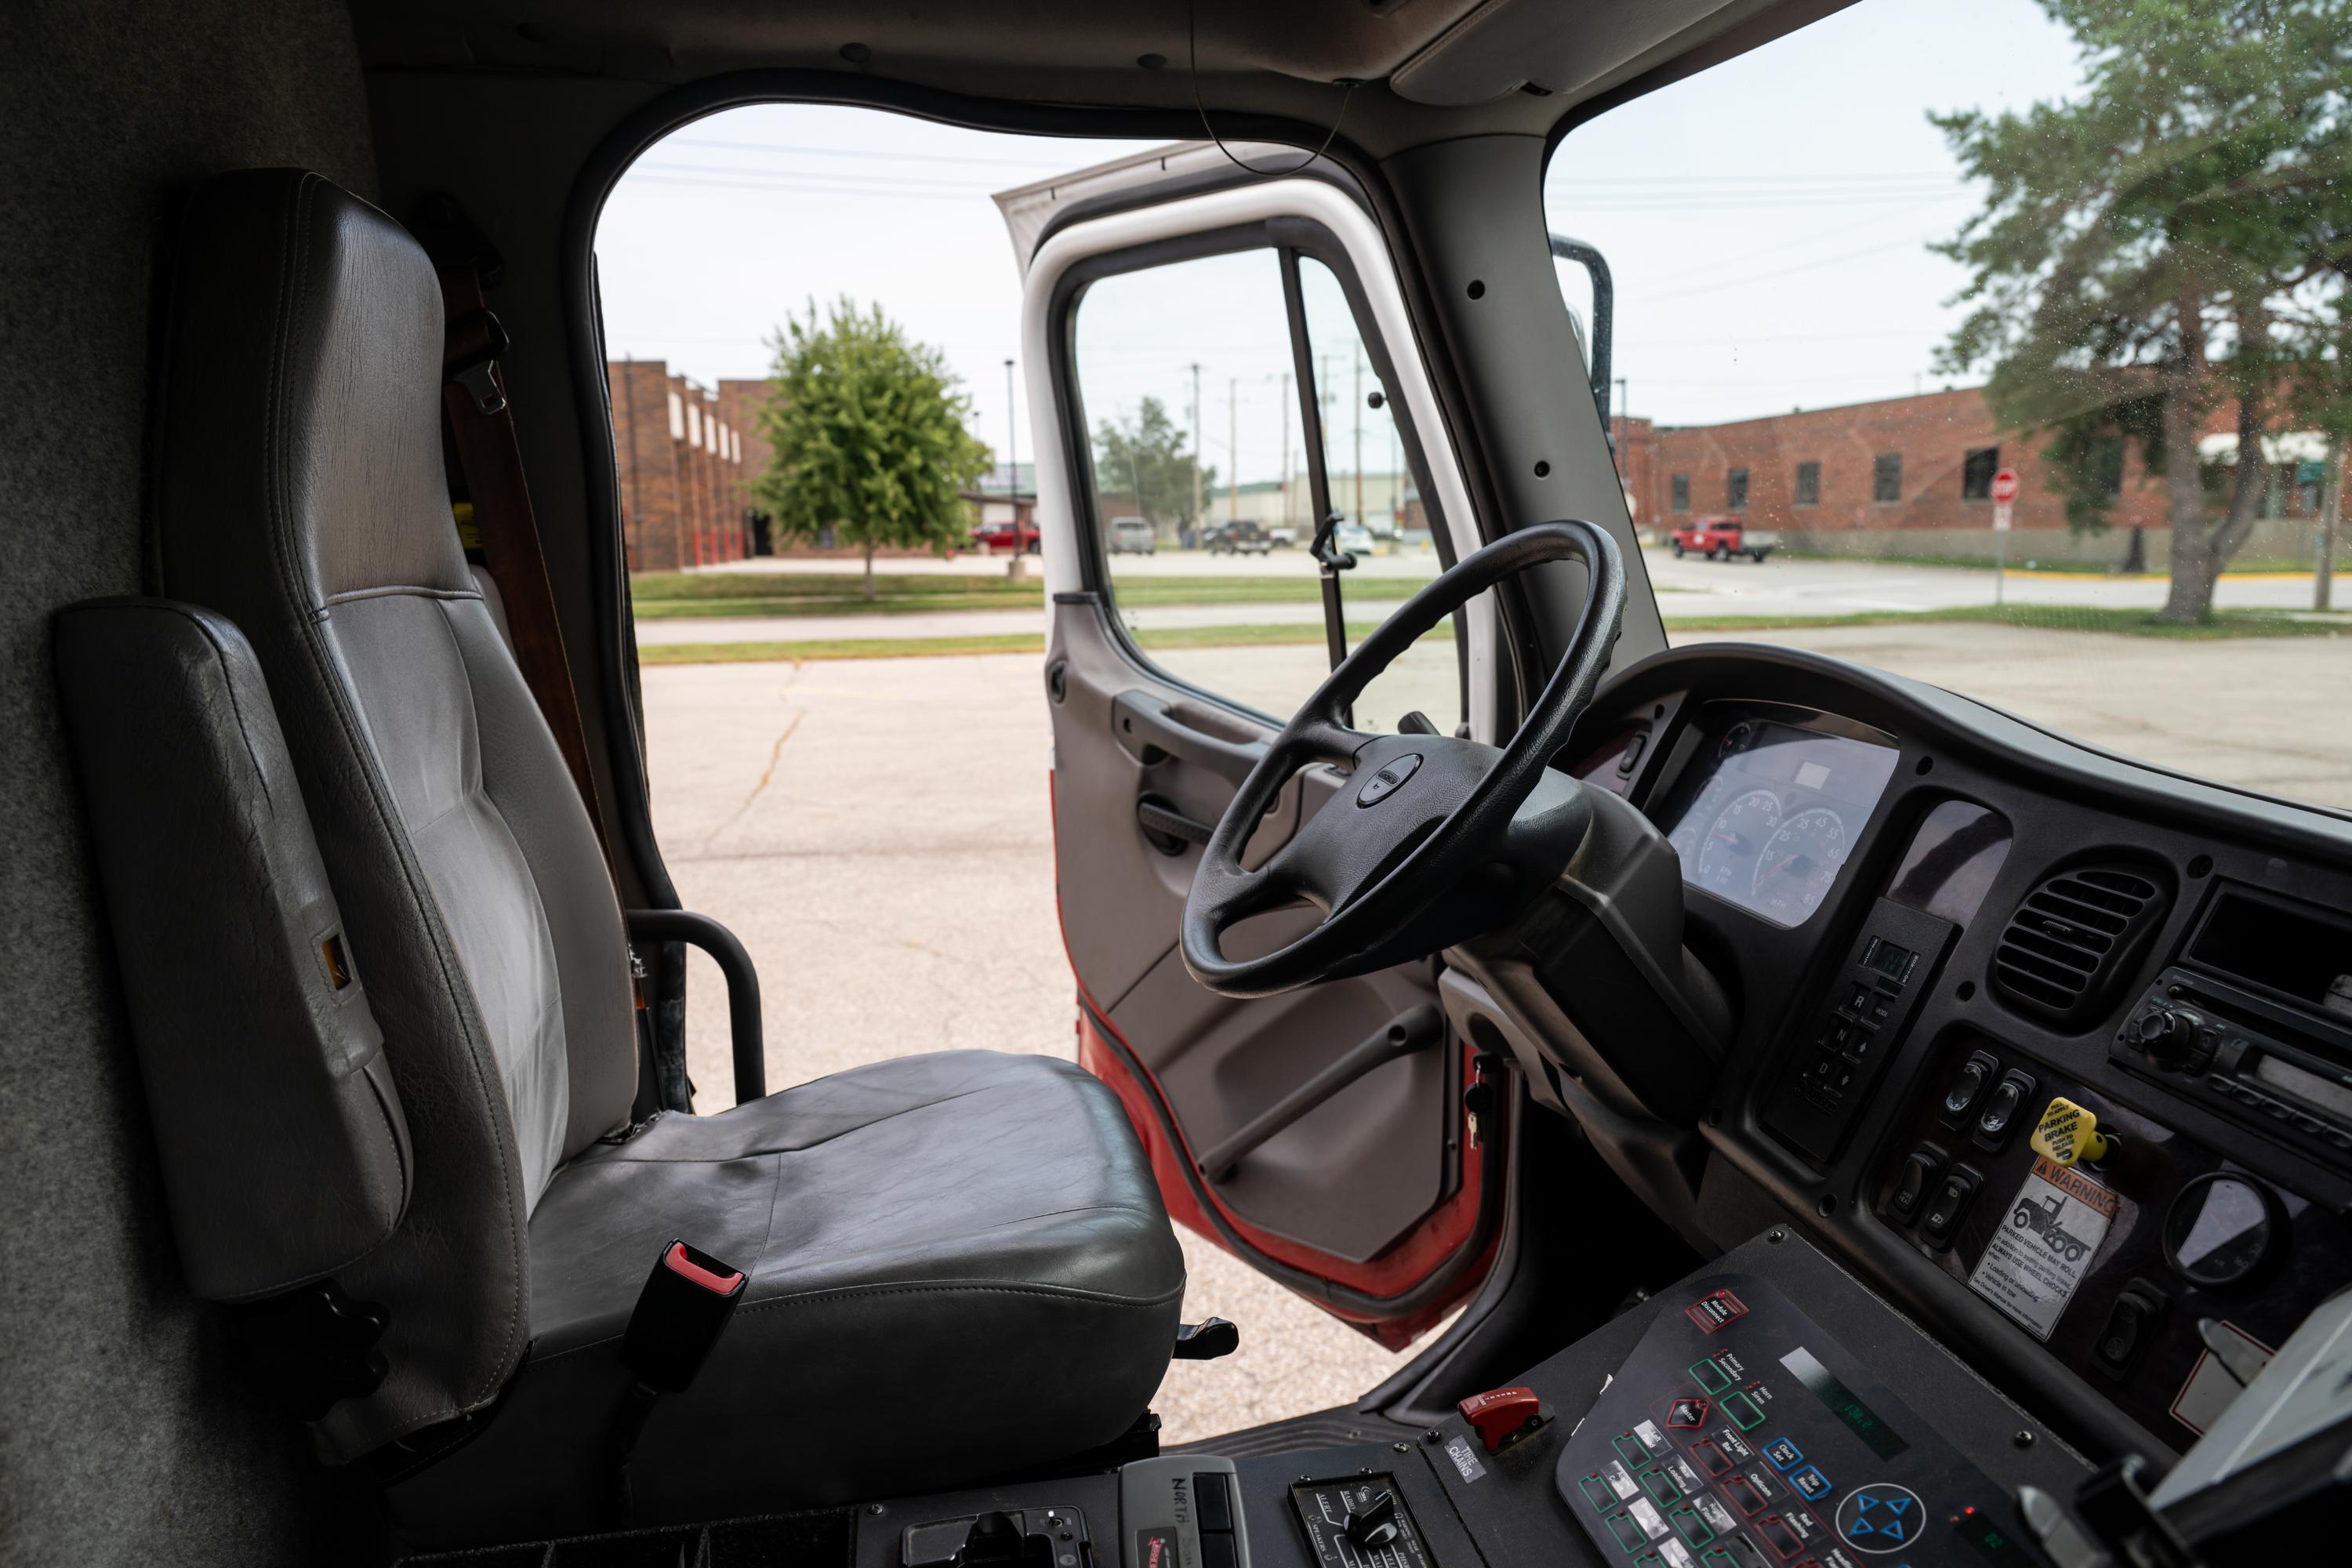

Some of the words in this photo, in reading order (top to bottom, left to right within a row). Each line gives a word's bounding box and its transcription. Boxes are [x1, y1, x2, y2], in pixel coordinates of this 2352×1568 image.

[1854, 995, 1864, 1008] R
[1836, 1029, 1847, 1041] N
[1818, 1062, 1828, 1075] D
[2038, 1109, 2080, 1133] PARKING
[2045, 1121, 2078, 1142] BRAKE
[2049, 1166, 2115, 1214] WARNING
[2002, 1225, 2024, 1243] PARKED
[2023, 1239, 2048, 1259] VEHICLE
[2046, 1254, 2061, 1267] MAY
[1985, 1272, 2002, 1288] Vehicle
[1989, 1263, 2009, 1281] Loading
[1991, 1243, 2013, 1260] ALWAYS
[2012, 1257, 2025, 1269] USE
[2023, 1264, 2042, 1282] WHEEL
[2042, 1277, 2068, 1298] CHOCKS
[1701, 1301, 1725, 1323] Disconnect
[1711, 1299, 1729, 1316] Module
[1718, 1357, 1743, 1381] Secondary
[1726, 1352, 1745, 1371] Primary
[1751, 1391, 1766, 1405] Siren
[1759, 1386, 1773, 1399] Horn
[1679, 1404, 1697, 1422] Master
[1722, 1428, 1737, 1444] Front
[1733, 1442, 1750, 1457] Light
[1722, 1441, 1733, 1453] Bar
[1449, 1446, 1472, 1476] CHAINS
[1461, 1446, 1478, 1466] TIRE
[1773, 1450, 1784, 1461] Set
[1778, 1444, 1795, 1461] Clock
[1667, 1465, 1686, 1489] Loading
[1750, 1473, 1773, 1497] Opticom
[1797, 1476, 1816, 1494] Reset
[1807, 1473, 1820, 1487] Trip
[1171, 1477, 1190, 1523] NORTH
[1319, 1494, 1332, 1513] ALERT
[1342, 1490, 1356, 1511] RADIO
[1785, 1512, 1810, 1539] Flashing
[1798, 1512, 1814, 1527] Red
[1312, 1523, 1327, 1552] SPEAKERS
